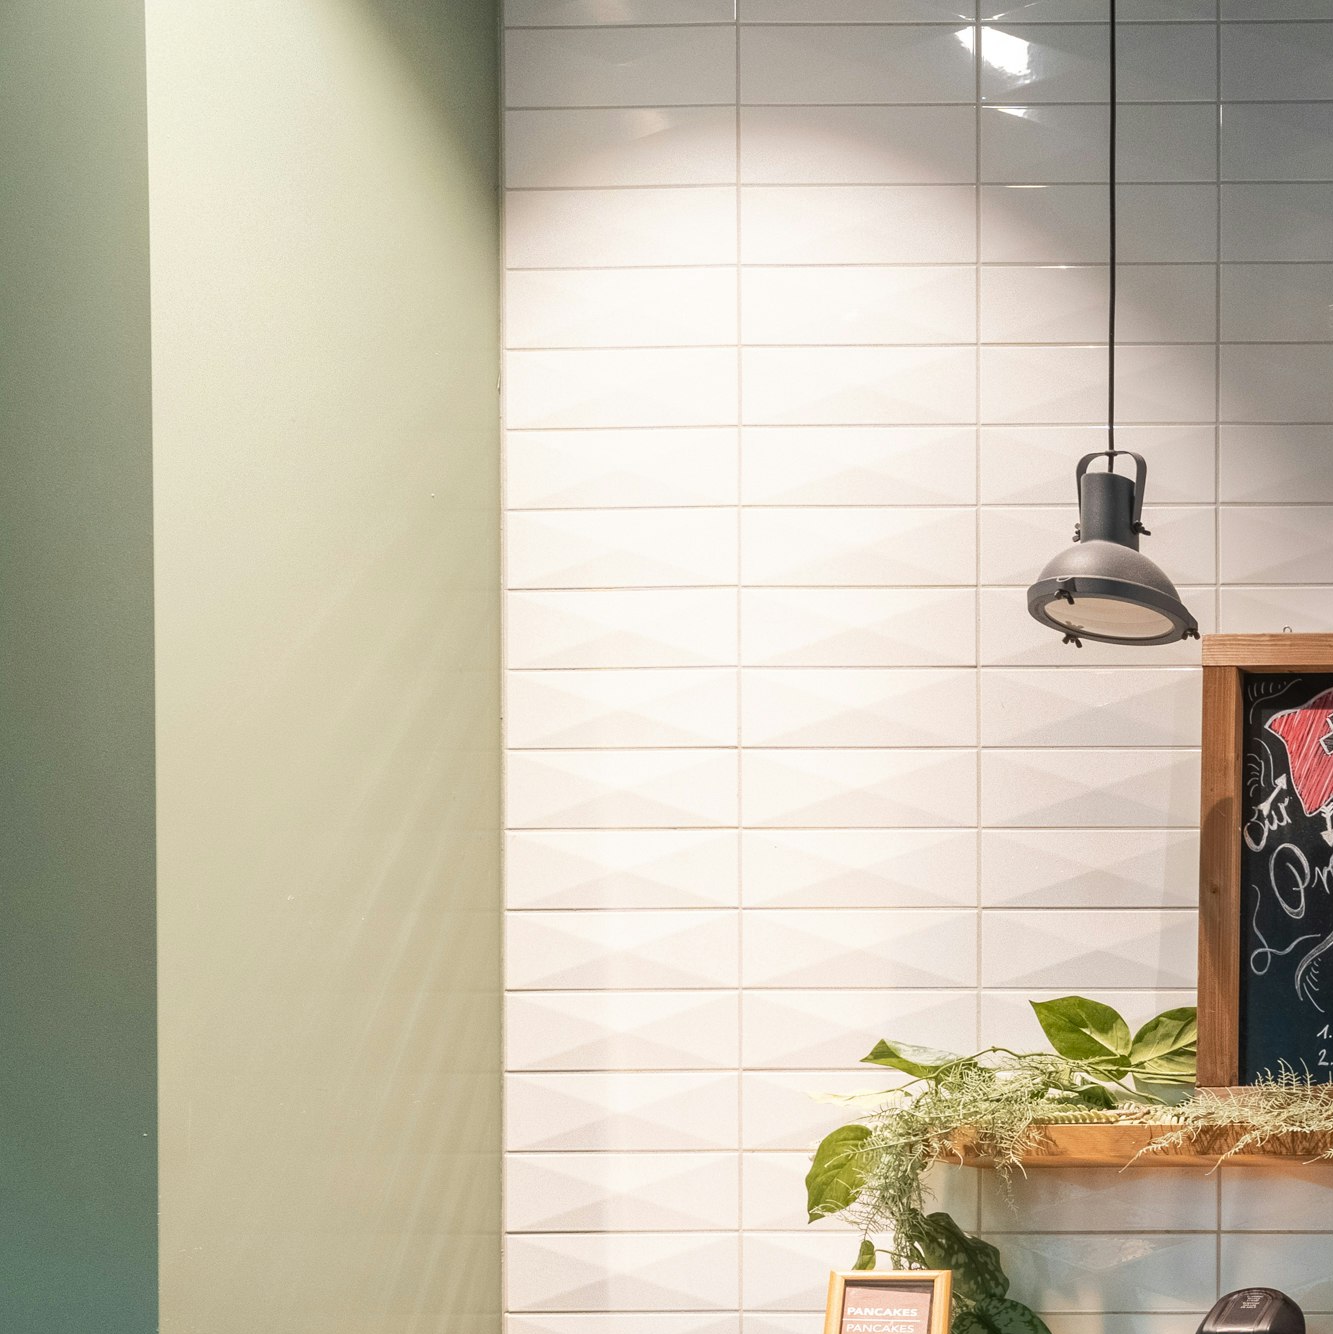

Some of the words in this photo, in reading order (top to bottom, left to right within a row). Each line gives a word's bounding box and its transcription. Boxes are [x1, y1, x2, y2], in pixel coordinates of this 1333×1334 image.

[1316, 1024, 1332, 1039] 1.
[1318, 1049, 1333, 1066] 2.
[847, 1307, 918, 1317] PANCAKES
[846, 1324, 914, 1333] PANCAKES
